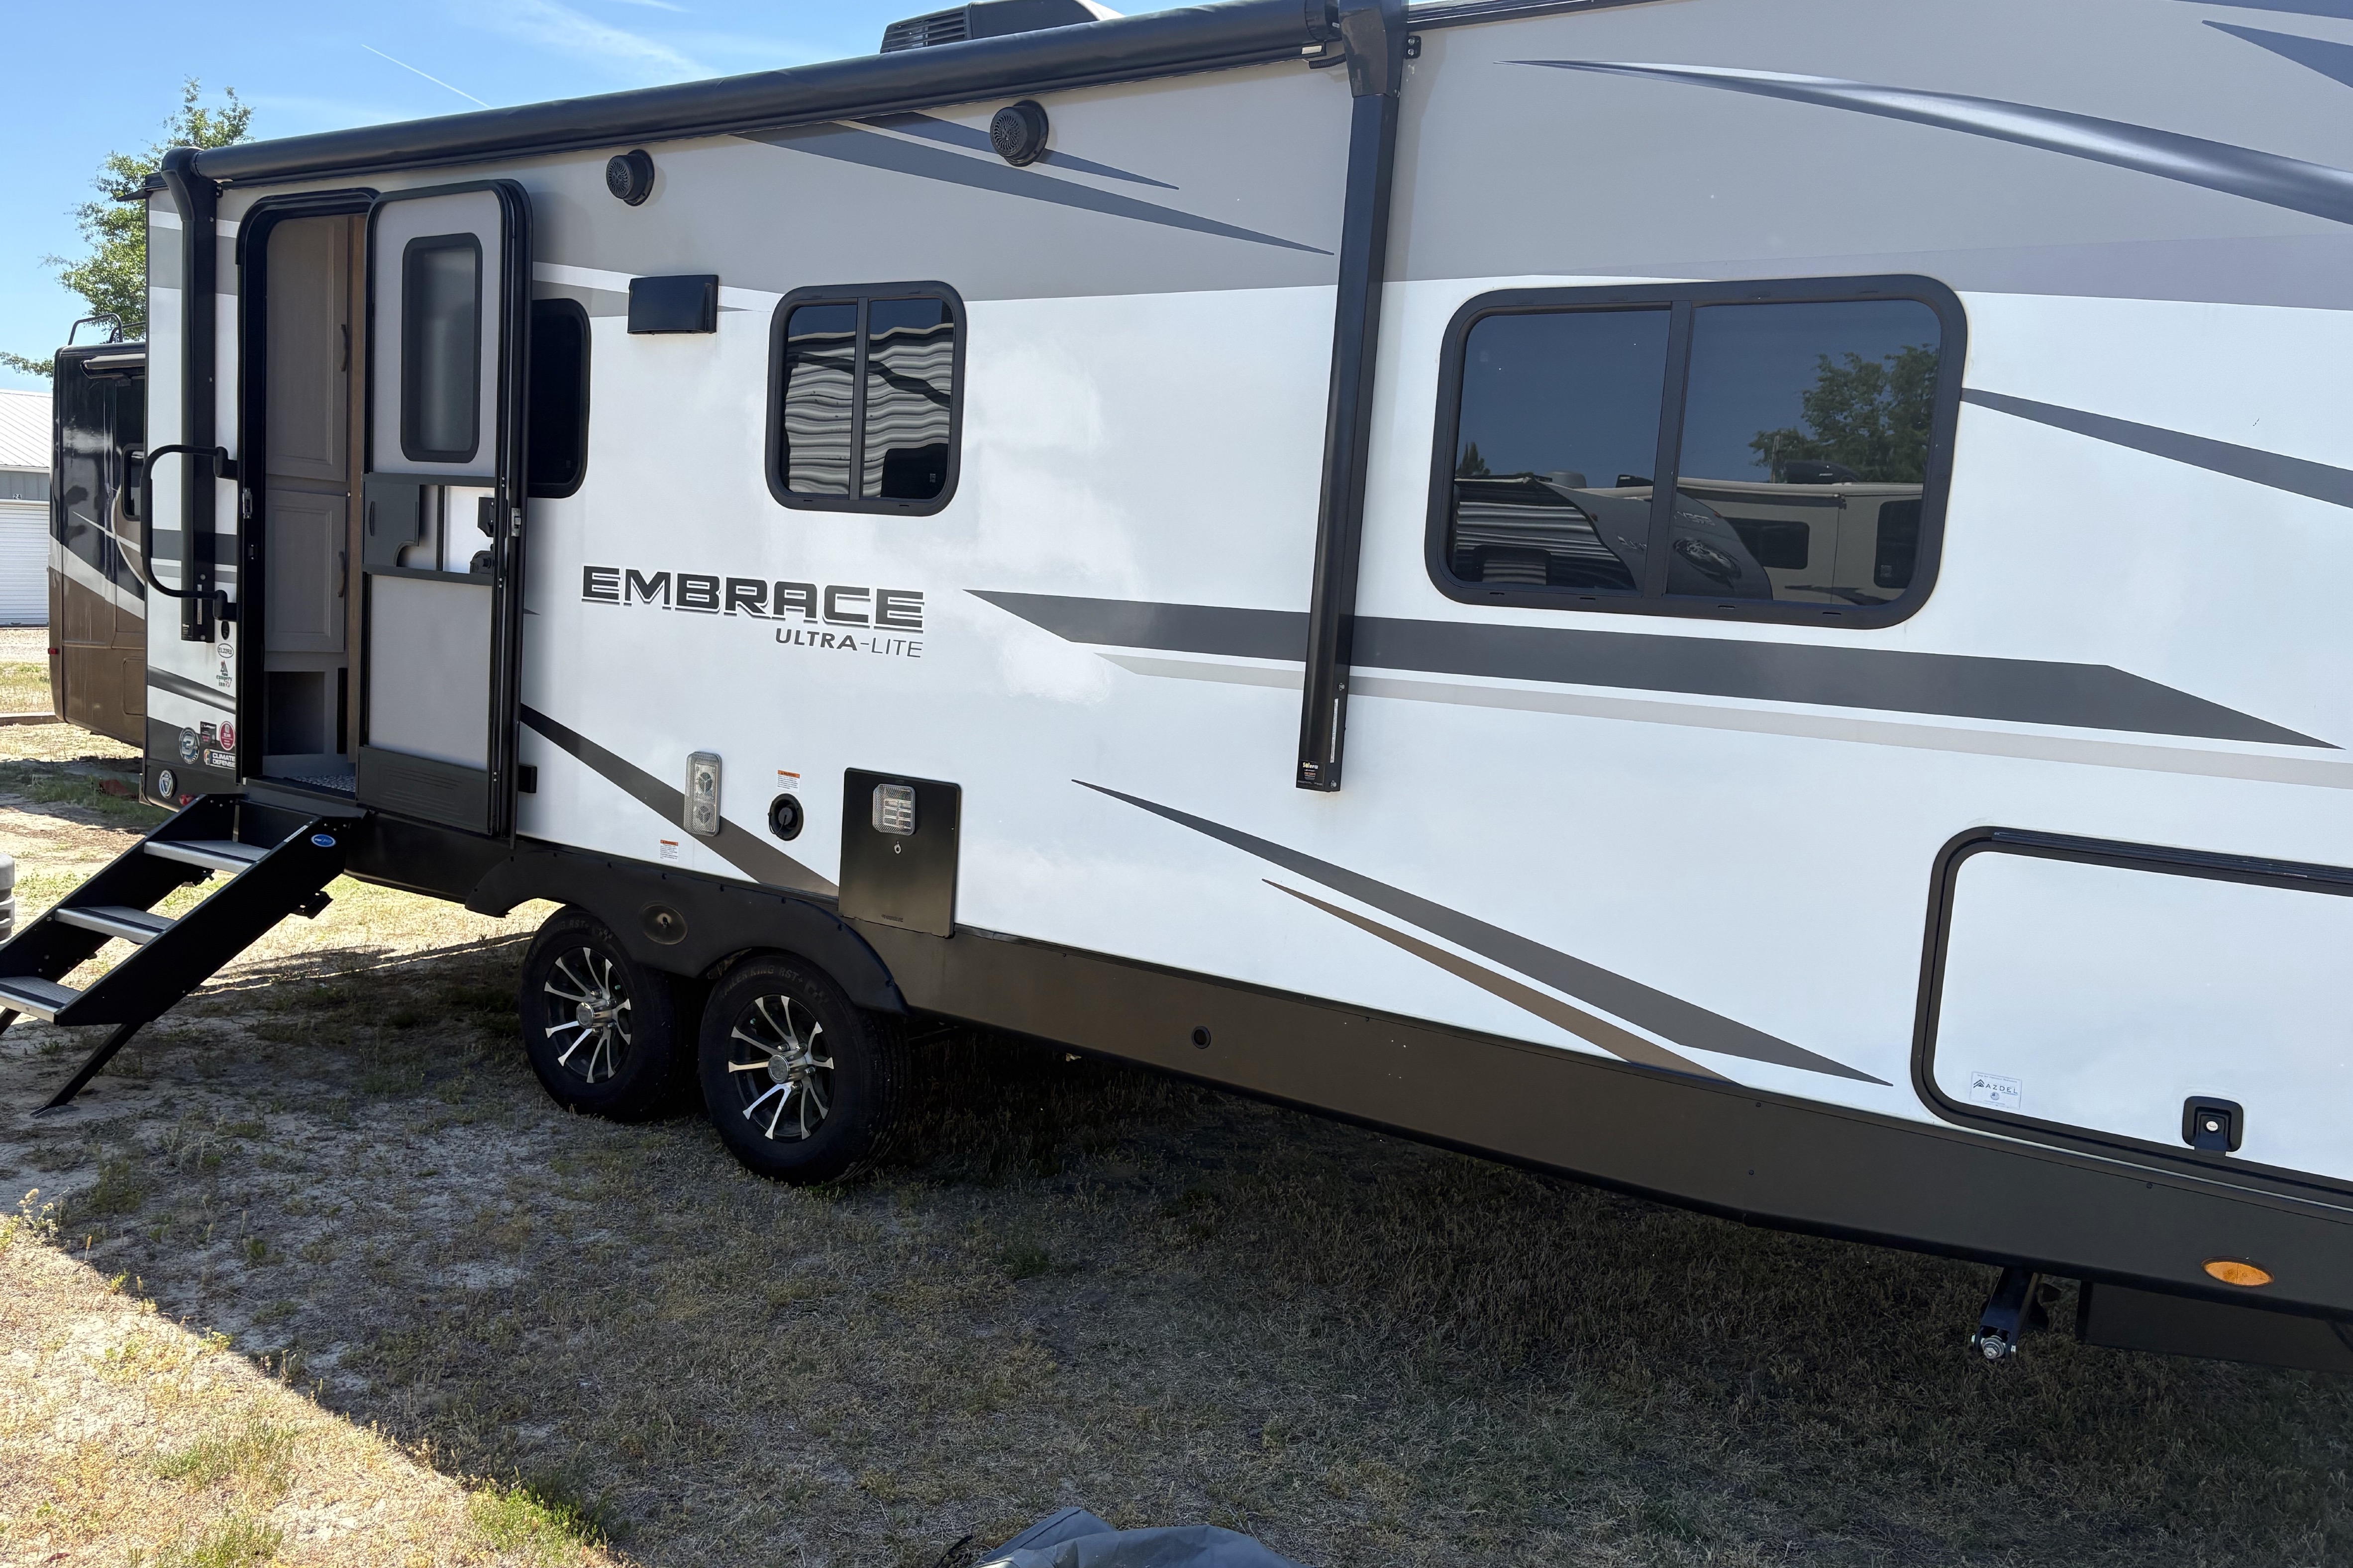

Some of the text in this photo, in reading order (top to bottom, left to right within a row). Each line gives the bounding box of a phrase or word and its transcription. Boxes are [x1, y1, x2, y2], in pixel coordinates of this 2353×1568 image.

[581, 565, 925, 634] EMBRACE
[775, 628, 923, 659] ULTRA-LITE
[212, 753, 236, 761] CLIMATE
[212, 759, 236, 768] DEFENSE
[1985, 1083, 2018, 1094] AZDEL
